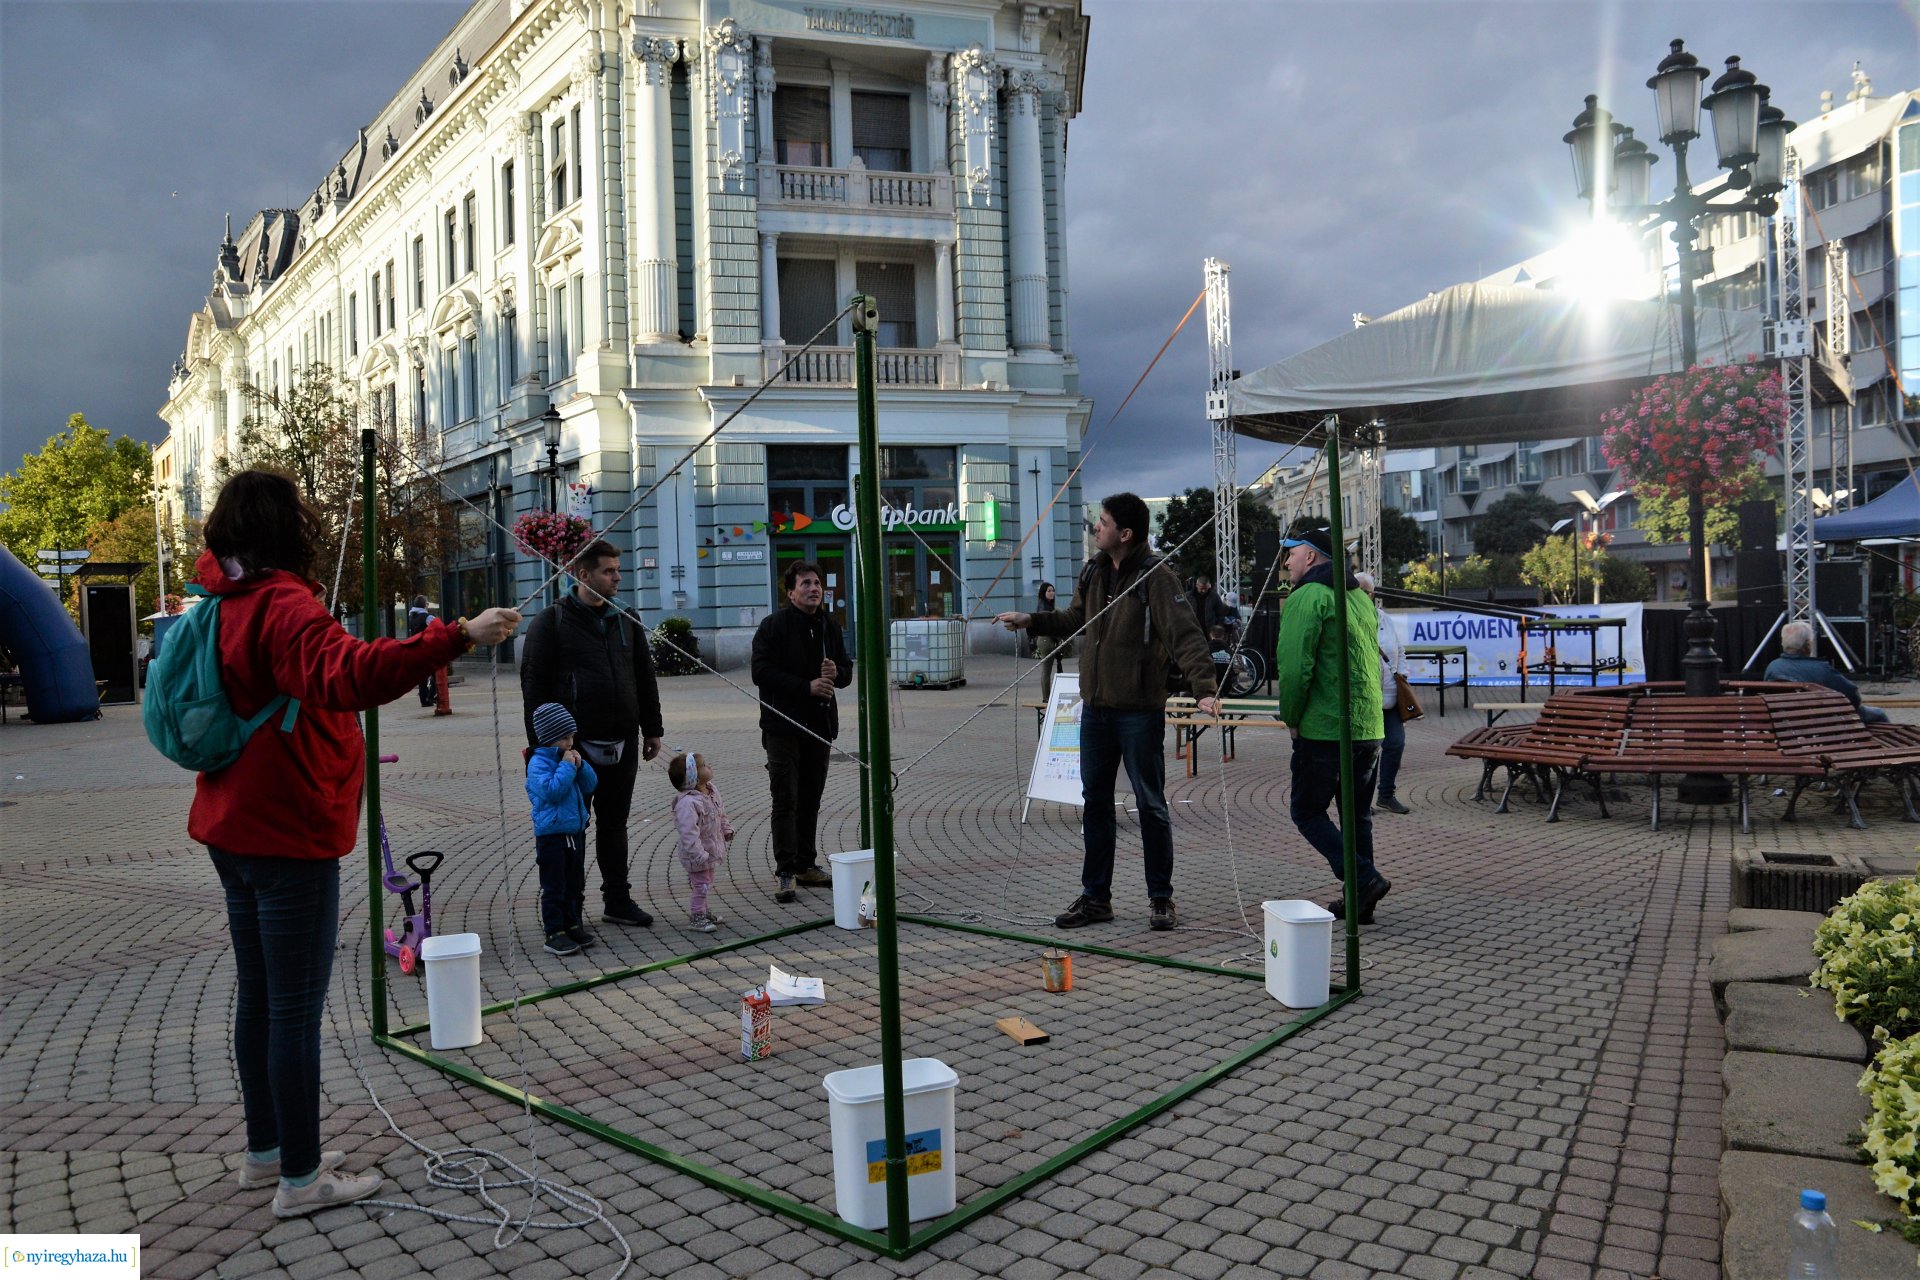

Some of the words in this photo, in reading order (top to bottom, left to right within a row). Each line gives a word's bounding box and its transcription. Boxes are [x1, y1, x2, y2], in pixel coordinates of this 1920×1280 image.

[803, 6, 916, 39] TAKARÉKPÉNZTÁR
[862, 502, 959, 532] tpbank
[1413, 614, 1548, 641] AUTÓMENES
